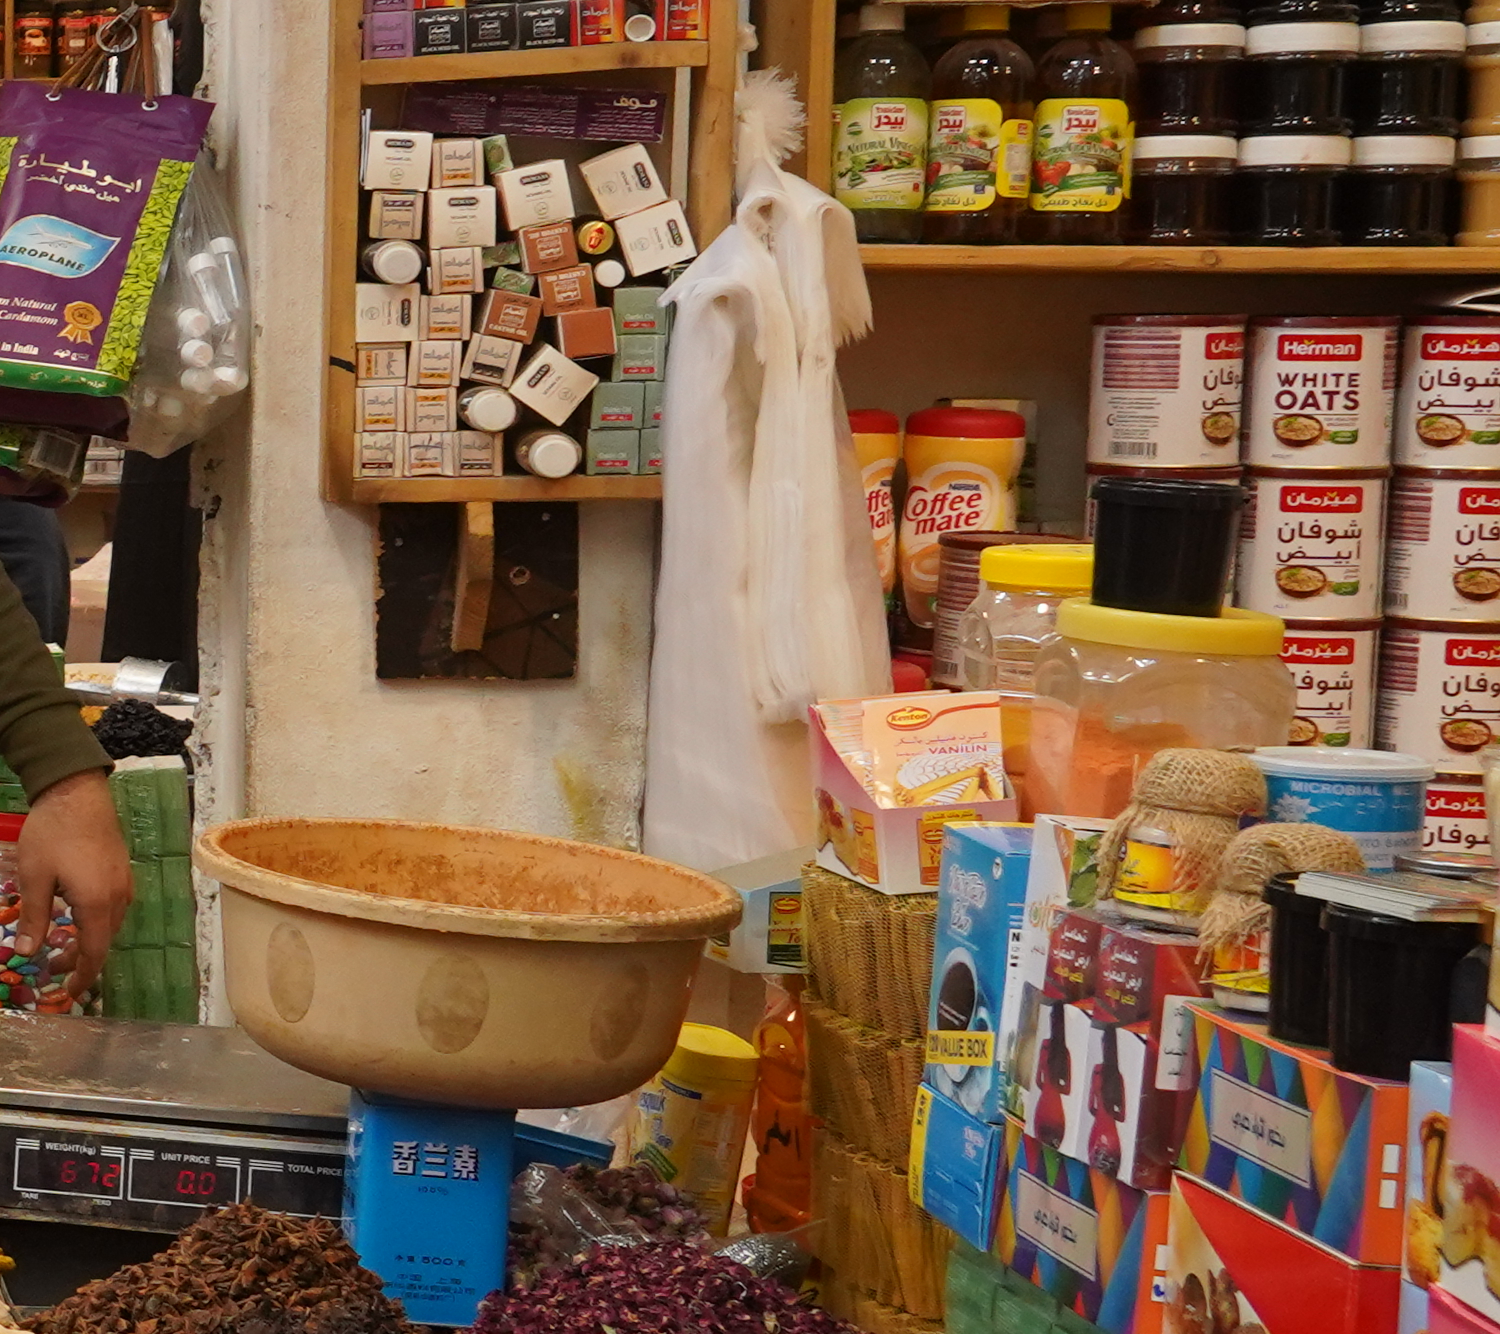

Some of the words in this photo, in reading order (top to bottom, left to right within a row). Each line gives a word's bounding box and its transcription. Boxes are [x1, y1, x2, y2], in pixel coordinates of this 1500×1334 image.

[874, 114, 906, 129] بيدر
[1064, 117, 1098, 131] بيدر
[18, 153, 97, 179] طيارة
[96, 173, 142, 193] ابو
[0, 244, 86, 273] AEROPLANE
[11, 296, 58, 312] Natural
[2, 339, 11, 351] in
[13, 341, 39, 355] India
[1283, 338, 1357, 357] Herman
[1276, 372, 1360, 388] WHITE
[1274, 390, 1360, 412] OATS
[904, 485, 982, 522] Coffee
[1285, 491, 1358, 507] هيرمان
[913, 510, 980, 535] mate
[1277, 520, 1363, 544] شوفان
[1275, 539, 1361, 565] أبيض
[1296, 670, 1354, 695] شوفا
[1290, 781, 1382, 797] MICROBIAL
[967, 1037, 988, 1059] BOX
[161, 1152, 181, 1162] UNIT
[182, 1153, 211, 1165] PRICE
[391, 1141, 480, 1182] 香兰素
[287, 1163, 313, 1175] TOTAL
[315, 1166, 343, 1177] PRICE
